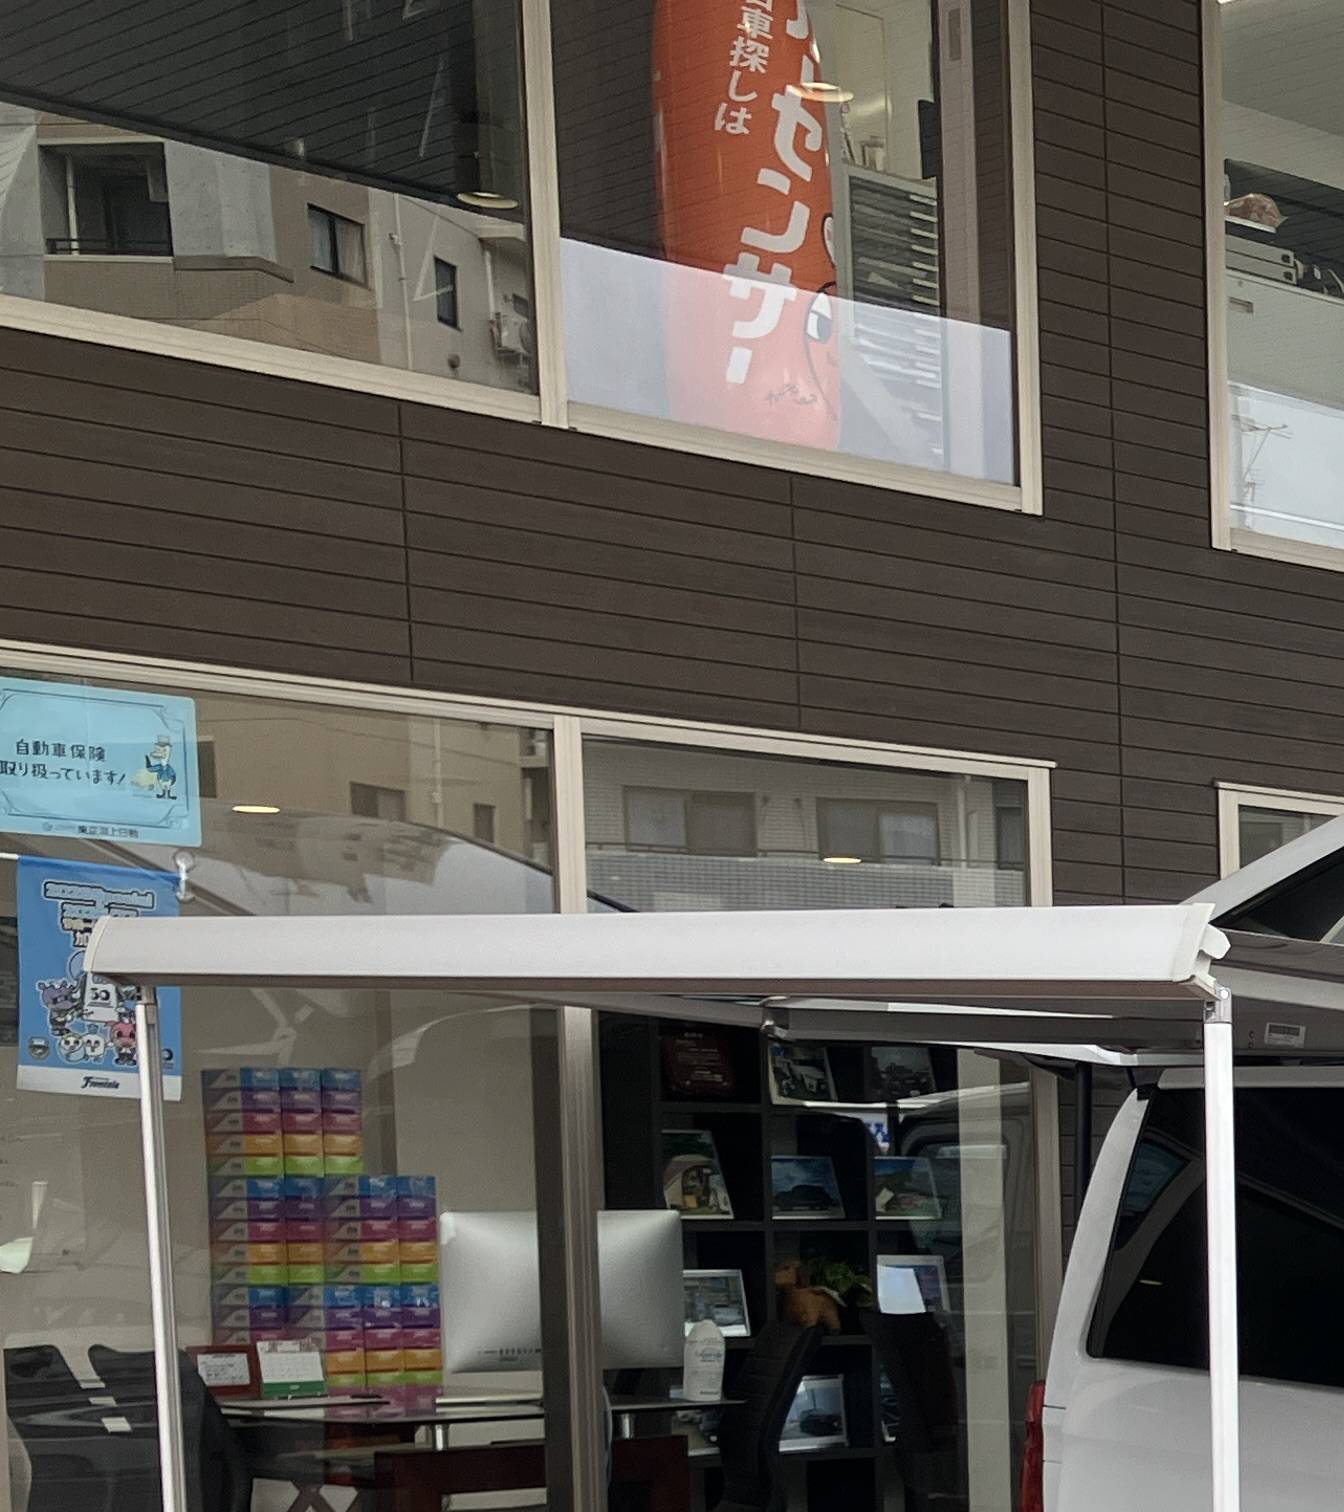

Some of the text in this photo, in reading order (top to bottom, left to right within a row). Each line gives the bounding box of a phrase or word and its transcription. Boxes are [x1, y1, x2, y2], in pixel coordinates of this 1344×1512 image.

[714, 0, 774, 136] 車探しは
[16, 739, 106, 762] 自動車保険
